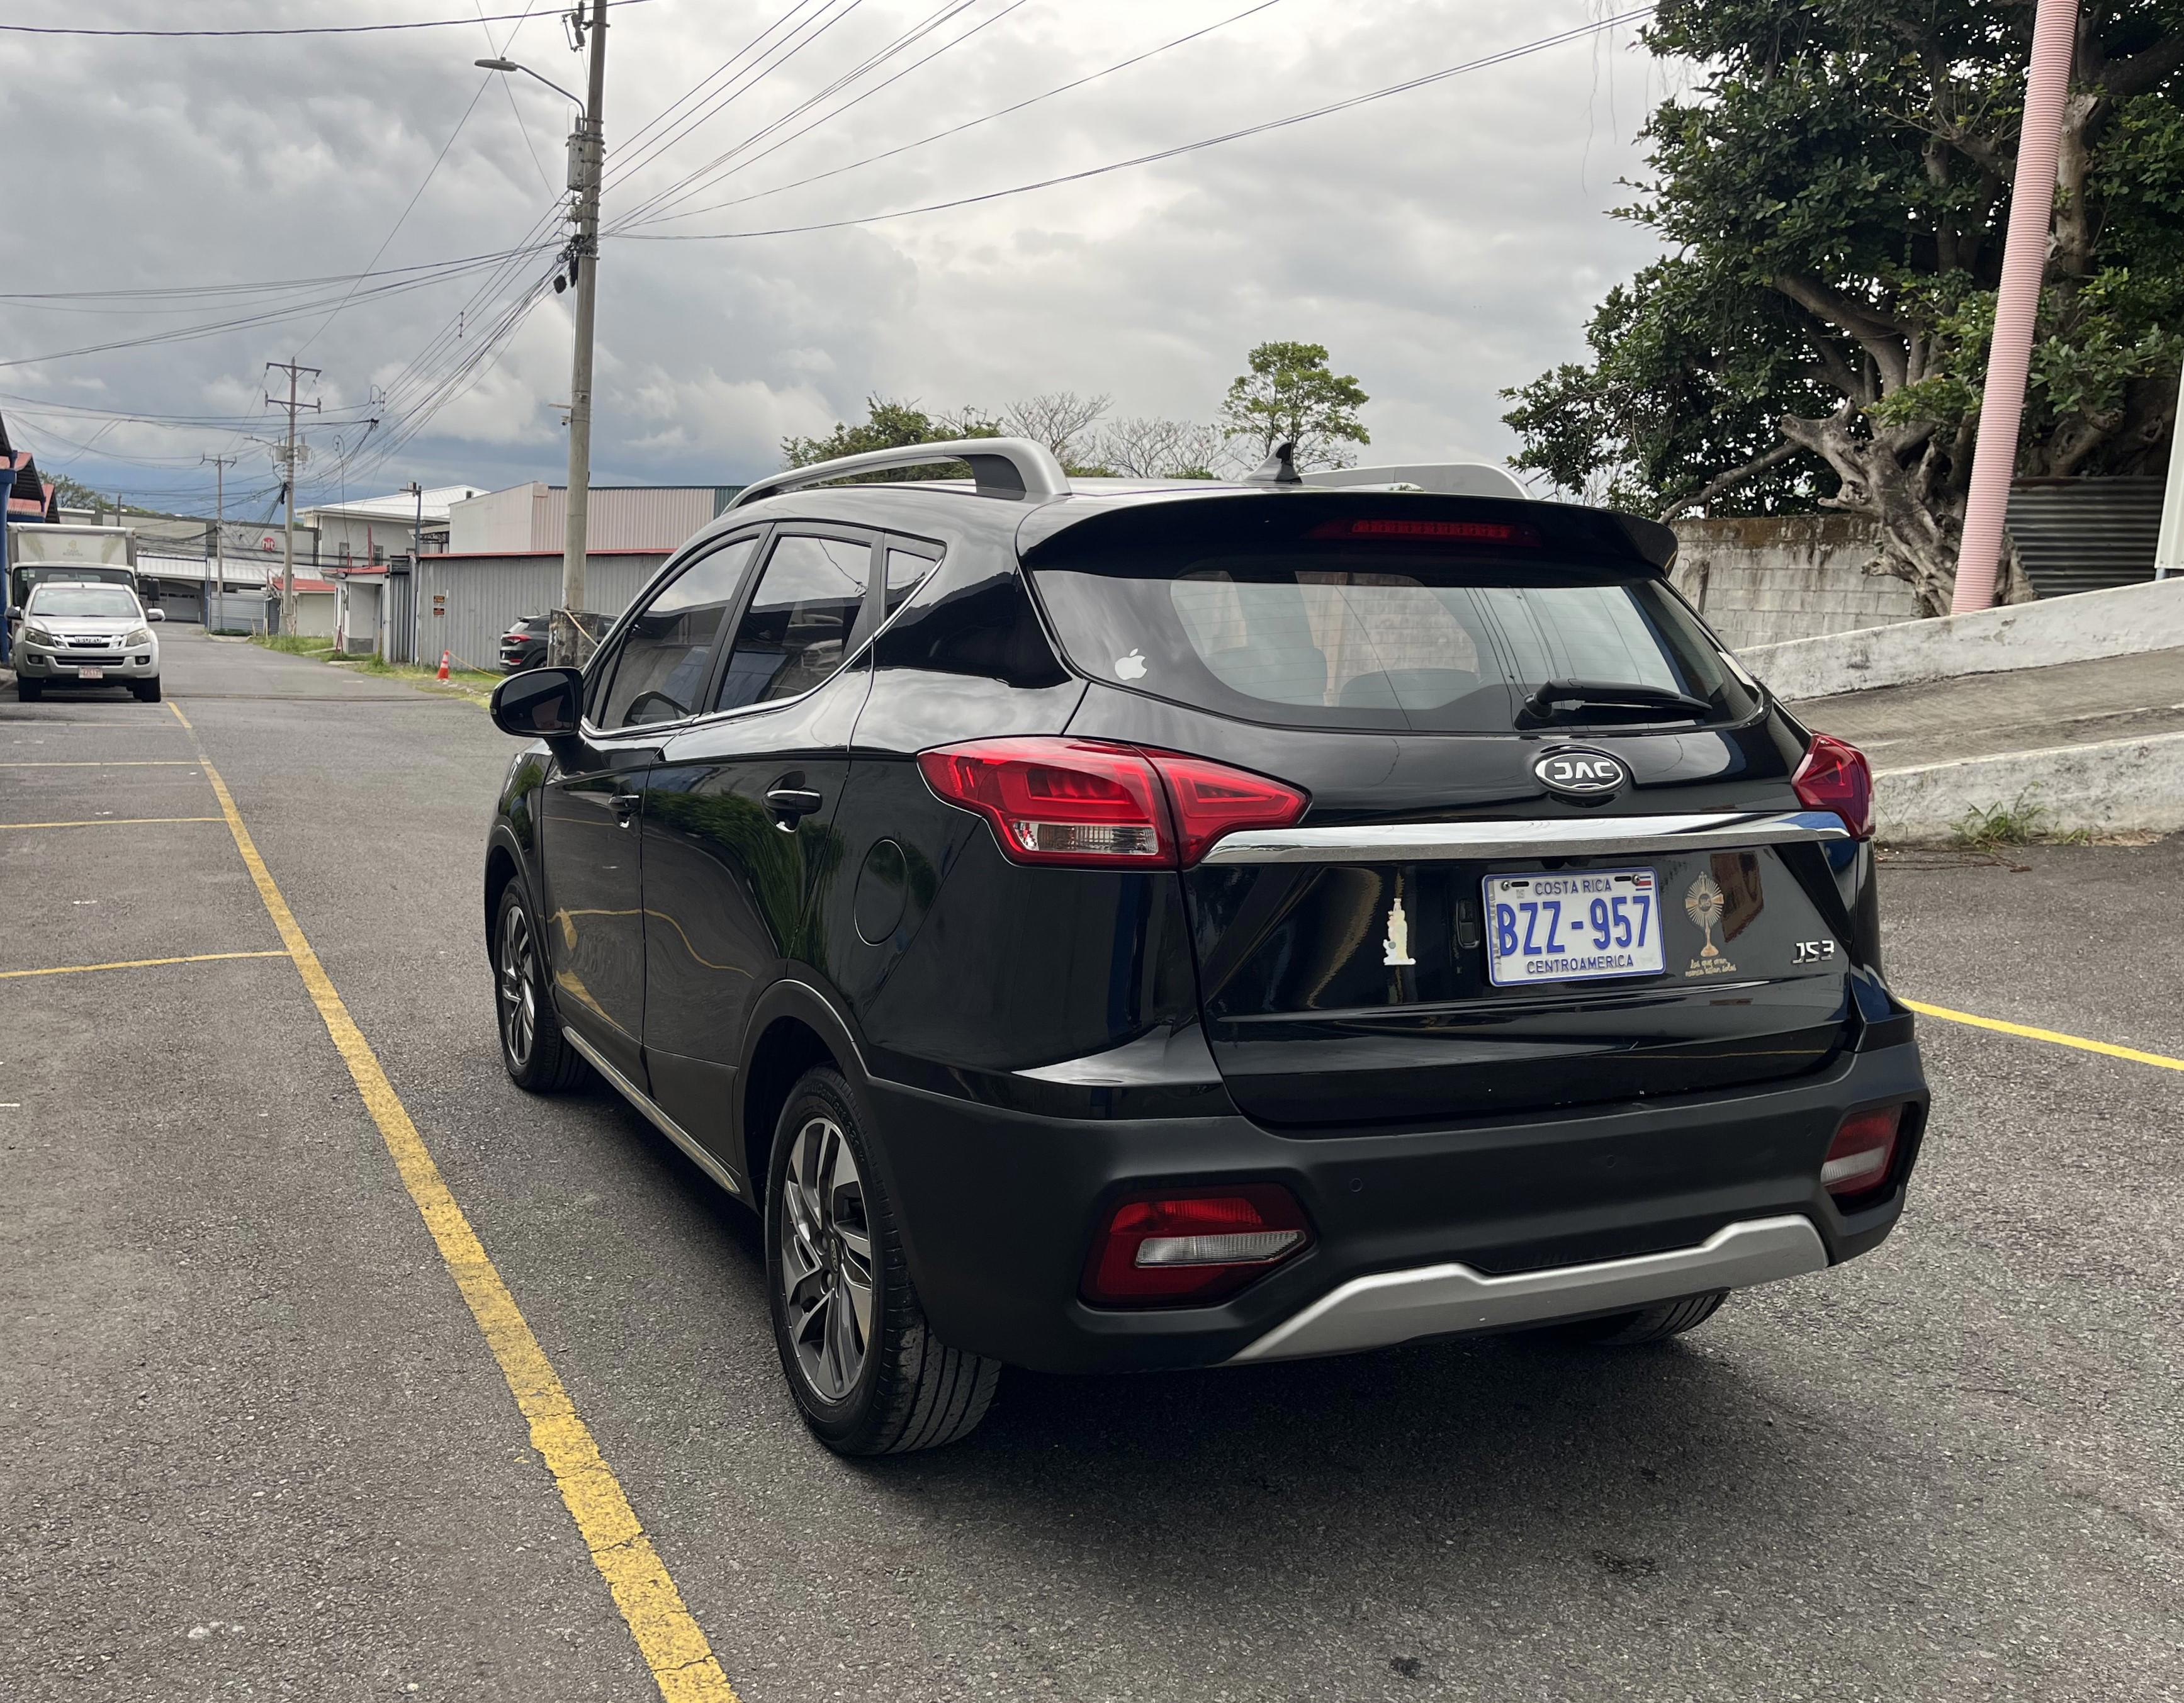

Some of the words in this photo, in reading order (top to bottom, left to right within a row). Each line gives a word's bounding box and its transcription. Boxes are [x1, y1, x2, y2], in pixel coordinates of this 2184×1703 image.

[262, 539, 275, 549] hit
[1553, 762, 1615, 780] JAC
[1534, 880, 1579, 896] COSTA
[1583, 879, 1613, 893] RICA
[1496, 895, 1650, 957] BZZ-957
[1793, 940, 1835, 964] JS3
[1526, 953, 1634, 974] CENTROAMERICA
